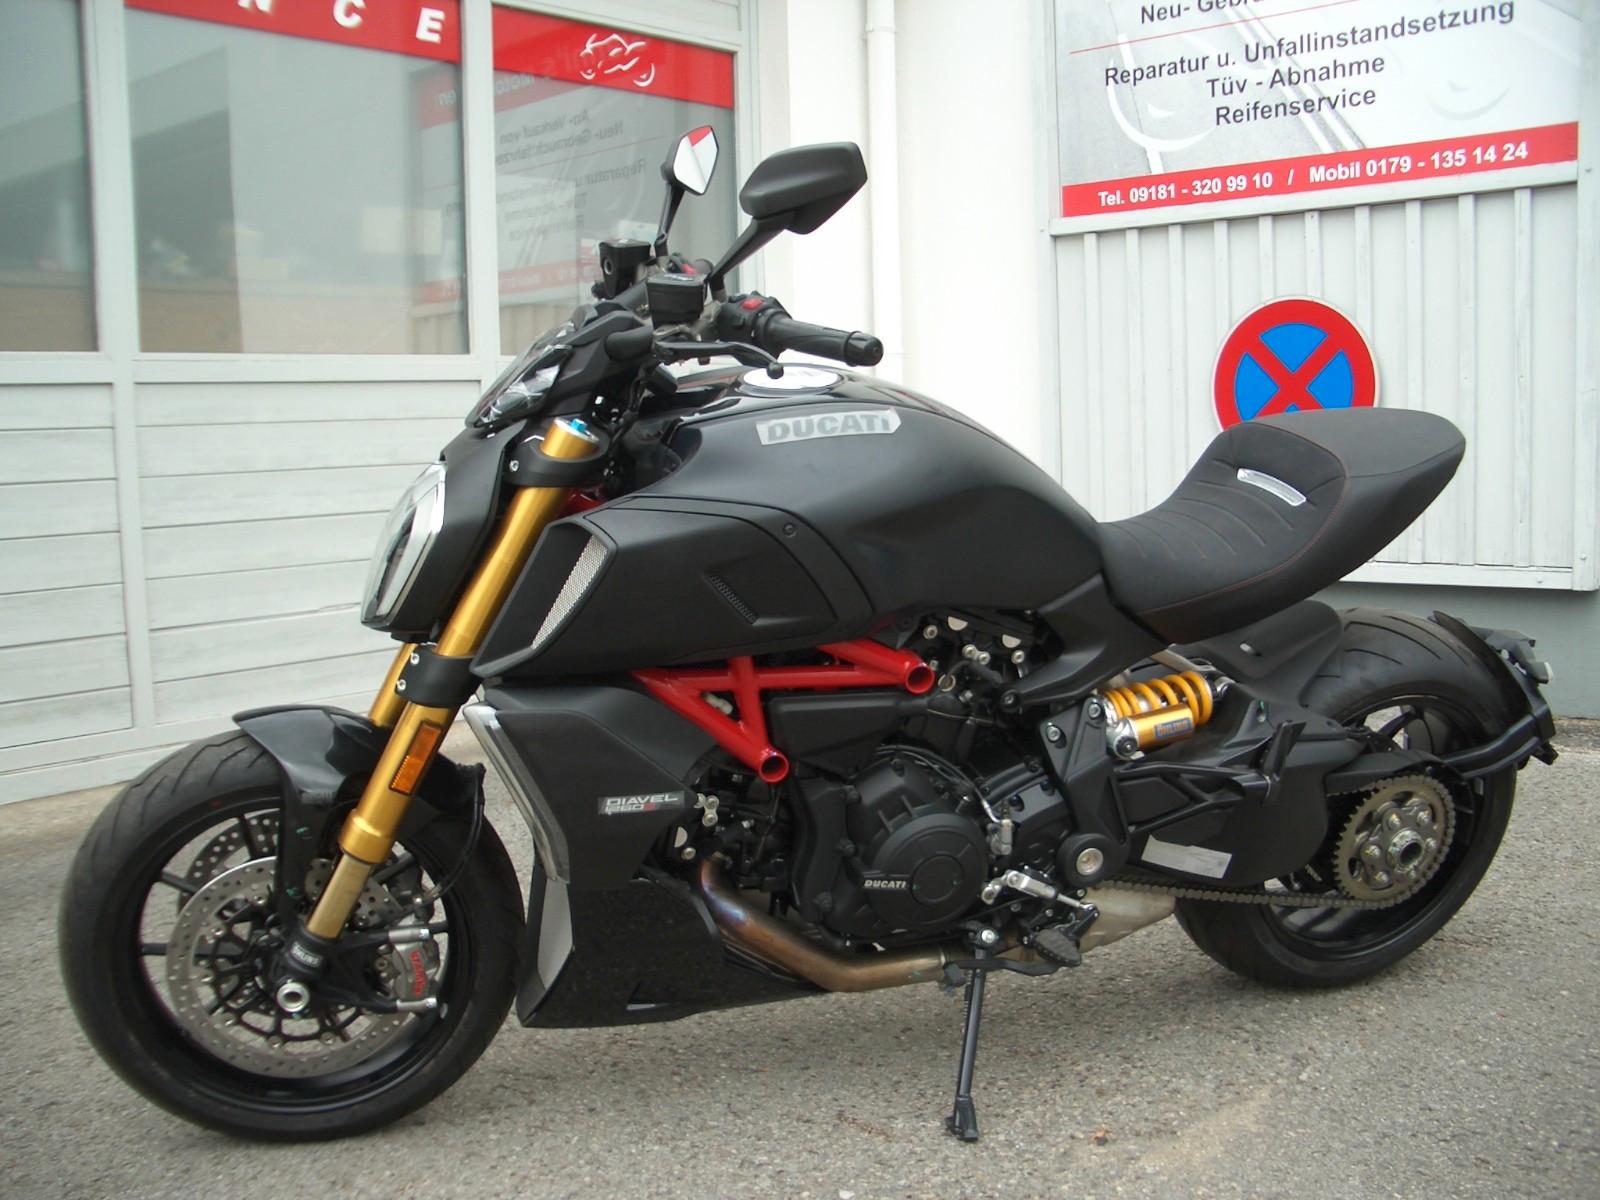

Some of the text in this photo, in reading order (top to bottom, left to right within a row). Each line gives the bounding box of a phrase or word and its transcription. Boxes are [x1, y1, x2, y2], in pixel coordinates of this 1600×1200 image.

[1141, 4, 1190, 25] Neu-
[1105, 0, 1515, 87] Reparatur u. Unfallinstandsetzung
[1206, 76, 1248, 98] Tüv
[1269, 56, 1386, 89] Abnahme
[1215, 87, 1377, 126] Reifenservice
[1098, 190, 1125, 207] Tel.
[1129, 182, 1176, 203] 09181
[1191, 178, 1222, 197] 320
[1226, 174, 1248, 192] 99
[1252, 171, 1274, 189] 10
[1309, 161, 1361, 184] Mobil
[1365, 155, 1412, 177] 0179
[1430, 149, 1467, 170] 135
[1472, 145, 1497, 165] 14
[1502, 141, 1529, 162] 24
[767, 414, 891, 442] DUCATI
[606, 794, 679, 805] DIAVEL
[864, 880, 907, 889] DUCATI
